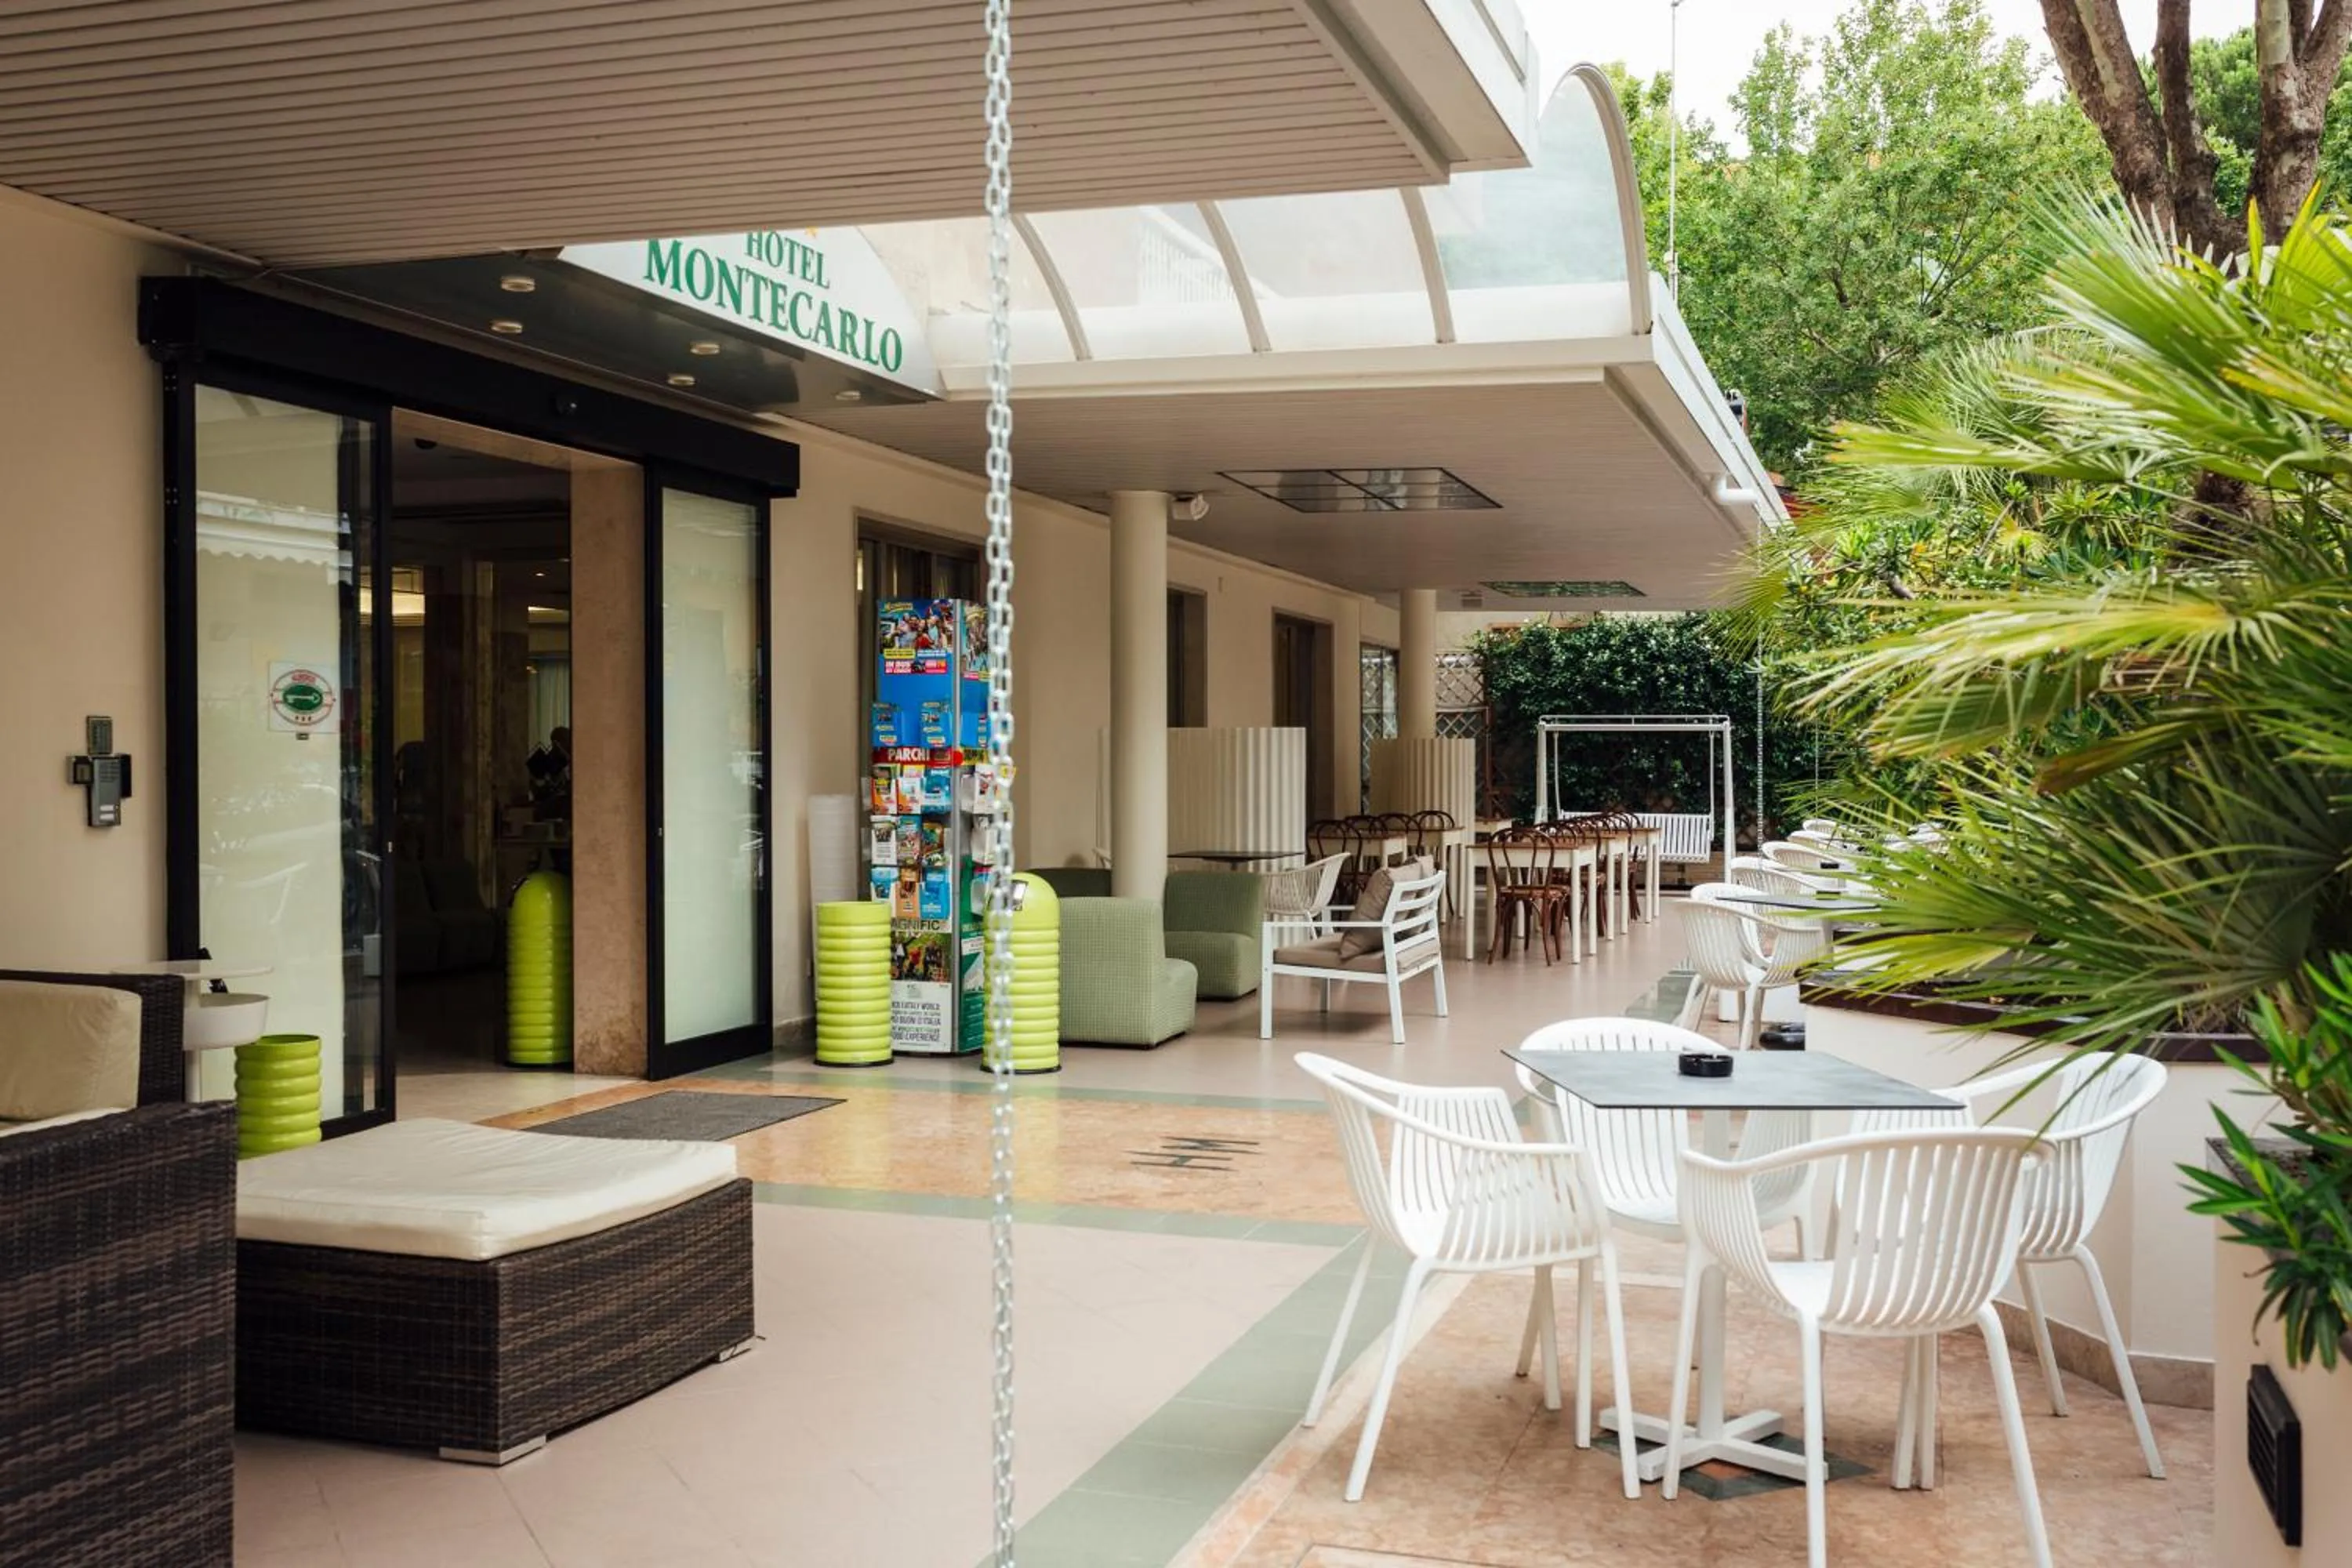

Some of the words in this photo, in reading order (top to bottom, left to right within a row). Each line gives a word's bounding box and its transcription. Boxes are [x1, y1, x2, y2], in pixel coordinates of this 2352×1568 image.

[744, 230, 830, 289] HOTEL
[643, 238, 903, 374] MONTECARLO
[887, 747, 931, 762] PARCHI
